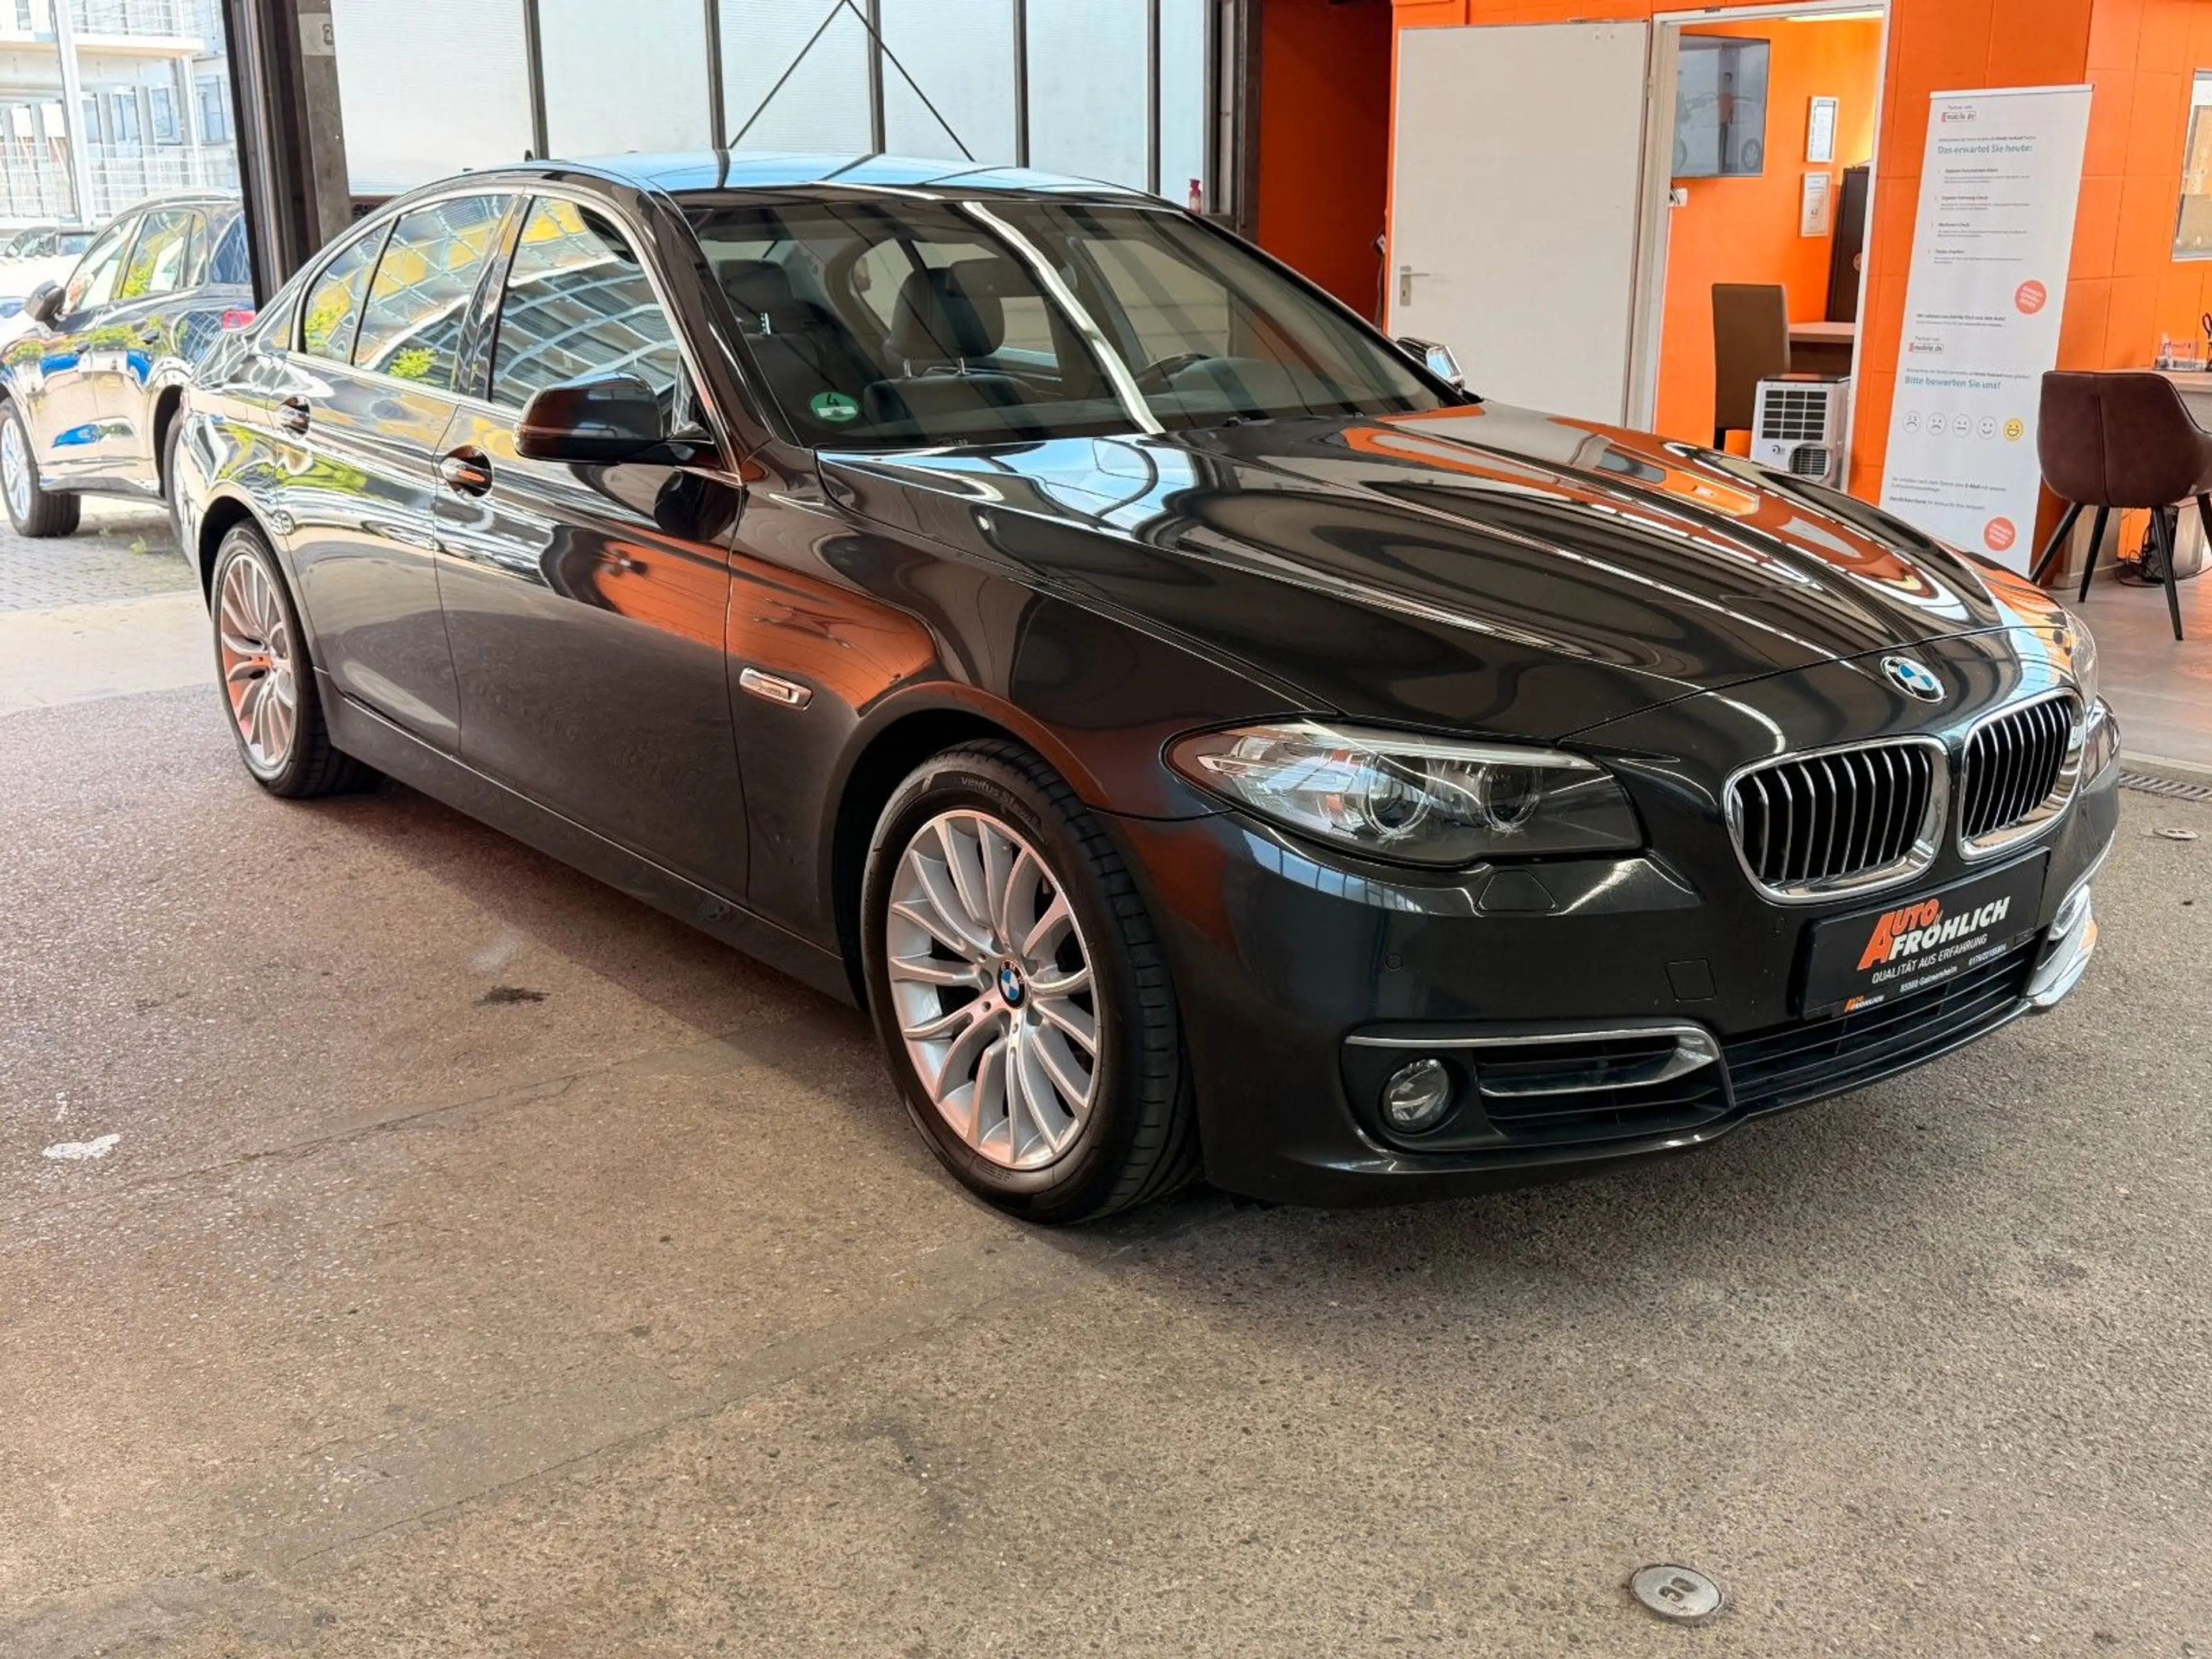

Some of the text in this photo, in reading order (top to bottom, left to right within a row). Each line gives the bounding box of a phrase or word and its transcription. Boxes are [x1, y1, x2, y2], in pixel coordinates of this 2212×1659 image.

[1991, 144, 2003, 153] Sie
[1905, 376, 1924, 384] Bitte
[1926, 377, 1966, 387] bewerten
[1968, 380, 1980, 388] Sie
[827, 394, 840, 407] 4
[1857, 898, 1940, 971] AUTO
[1888, 896, 2011, 960] FRÖHLICH
[1872, 959, 1918, 984] QUALITÄT
[1918, 953, 1937, 969] AUS
[1938, 933, 1987, 961] ERFAHRUNG
